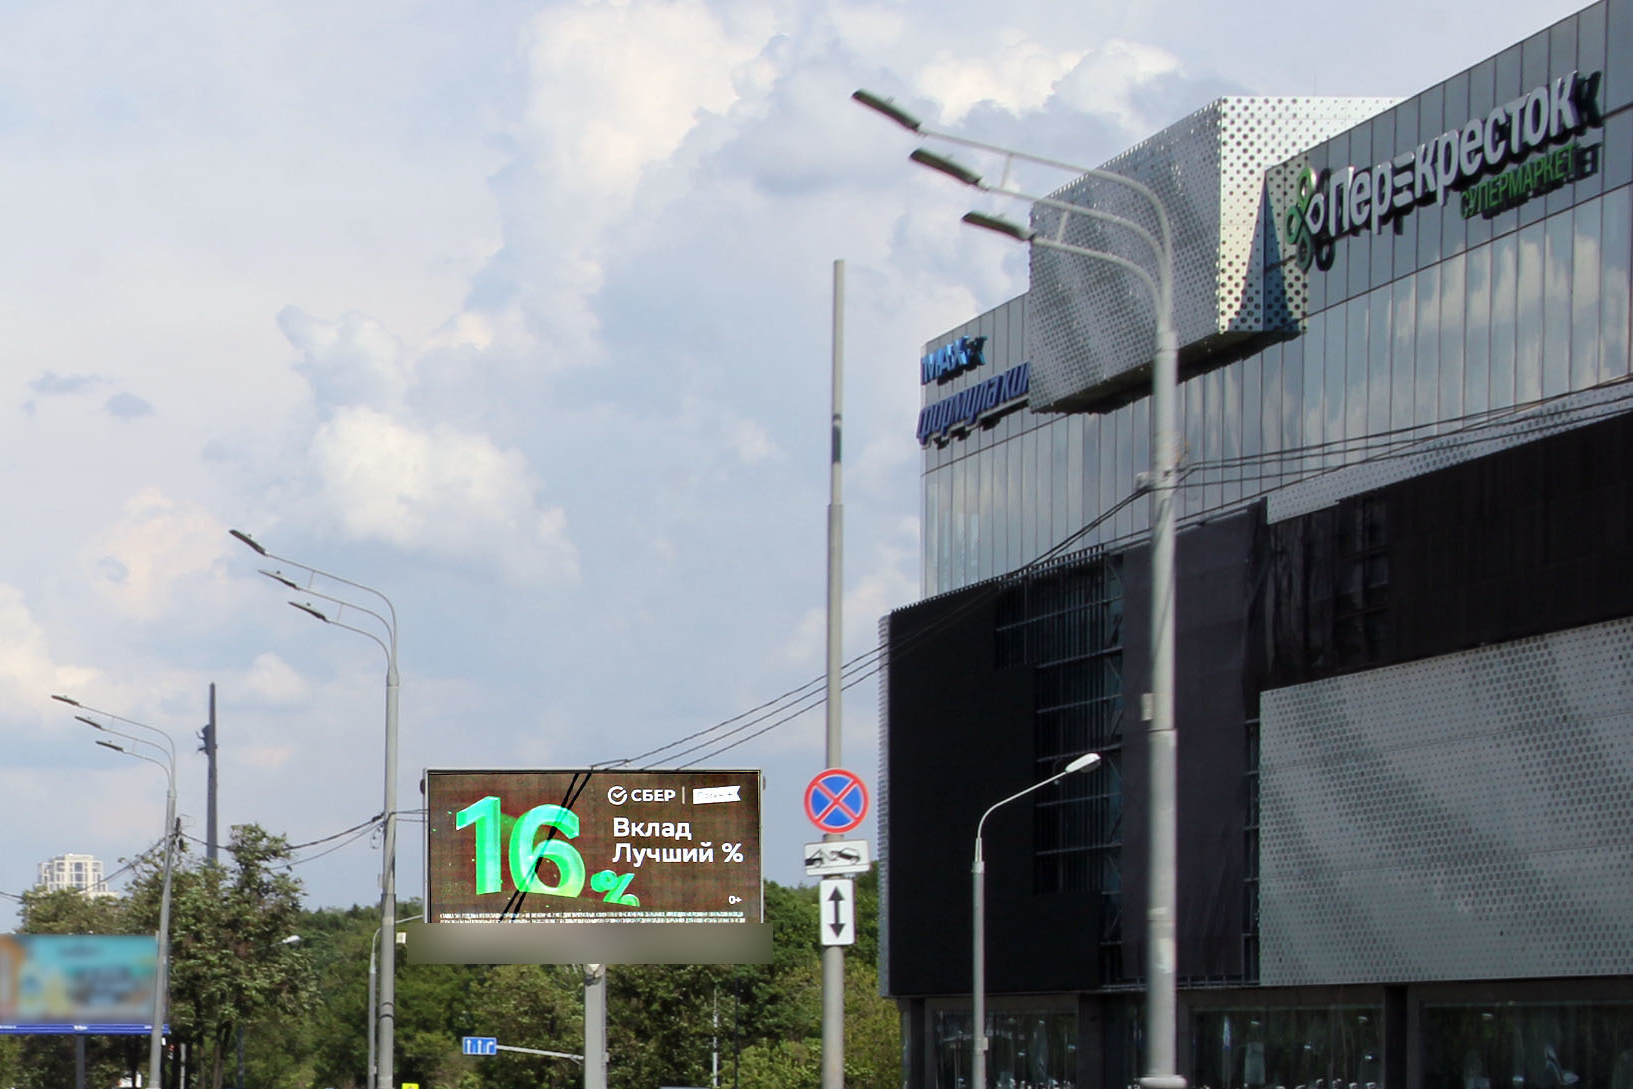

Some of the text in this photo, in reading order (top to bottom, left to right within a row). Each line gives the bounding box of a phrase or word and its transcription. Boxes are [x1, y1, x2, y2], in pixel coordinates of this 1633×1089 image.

[1460, 144, 1575, 220] СУПЕРМАРКЕТ
[630, 788, 676, 802] СБЕР
[613, 817, 692, 840] Вклад
[612, 841, 744, 868] Лучший %
